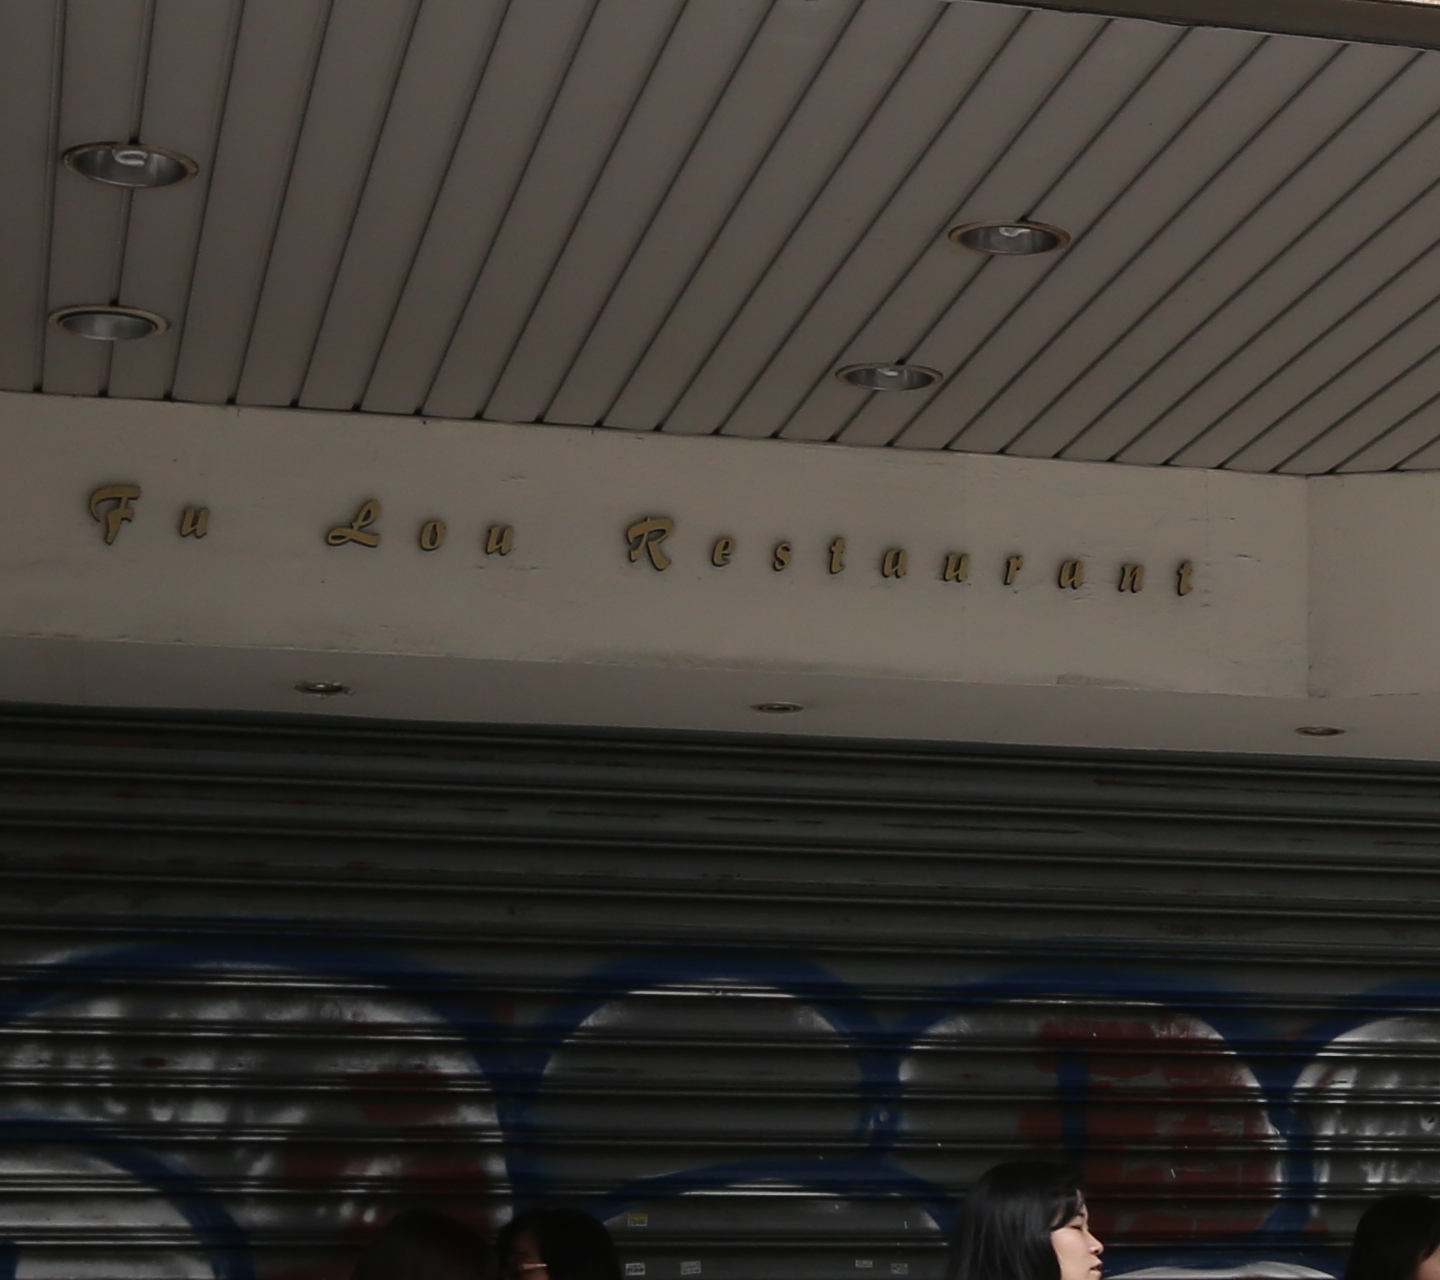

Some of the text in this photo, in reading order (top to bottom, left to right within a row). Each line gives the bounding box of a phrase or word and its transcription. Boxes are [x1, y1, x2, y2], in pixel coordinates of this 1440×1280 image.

[89, 485, 210, 545] Fu
[325, 497, 516, 557] Lou
[624, 515, 1195, 598] Restaurant
